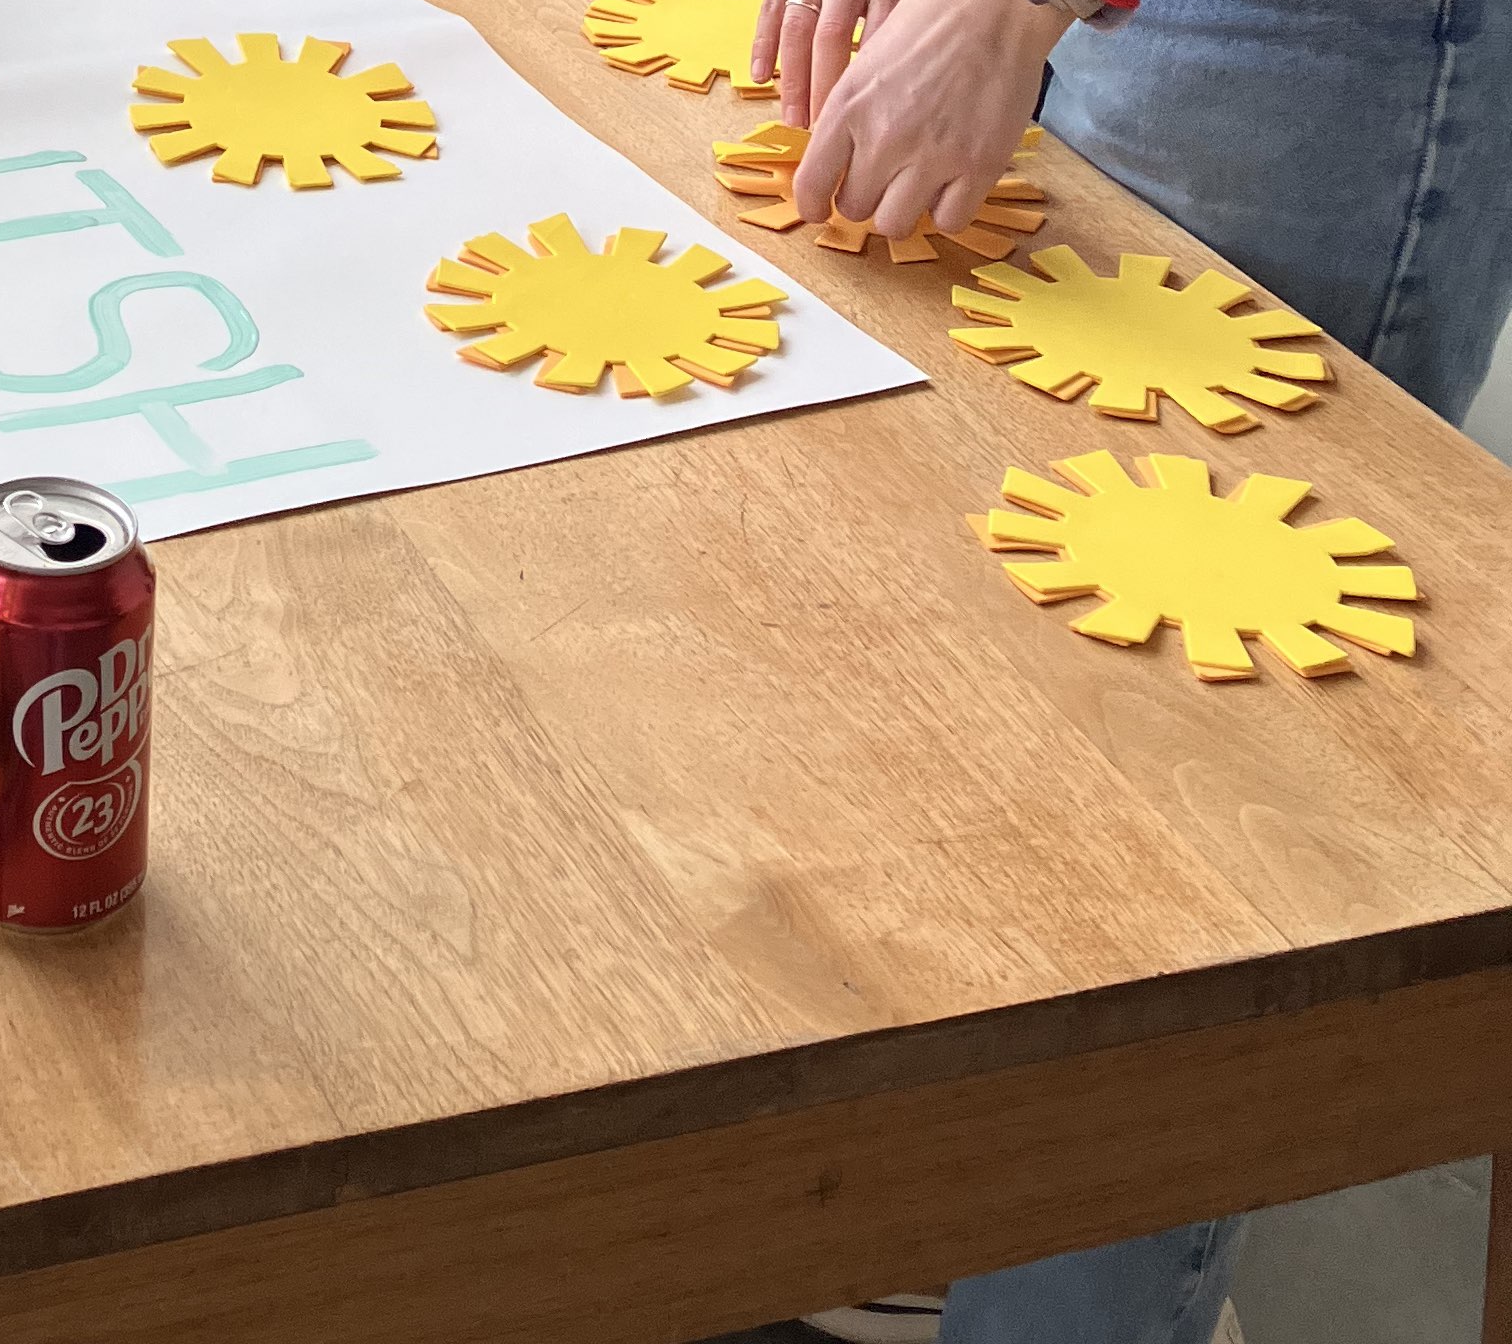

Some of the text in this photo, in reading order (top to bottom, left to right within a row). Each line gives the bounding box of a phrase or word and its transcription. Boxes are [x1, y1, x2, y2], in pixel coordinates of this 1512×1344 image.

[98, 622, 152, 711] Dr
[71, 793, 114, 839] 23
[72, 904, 87, 919] 12
[89, 899, 104, 914] FL
[104, 890, 118, 910] OZ
